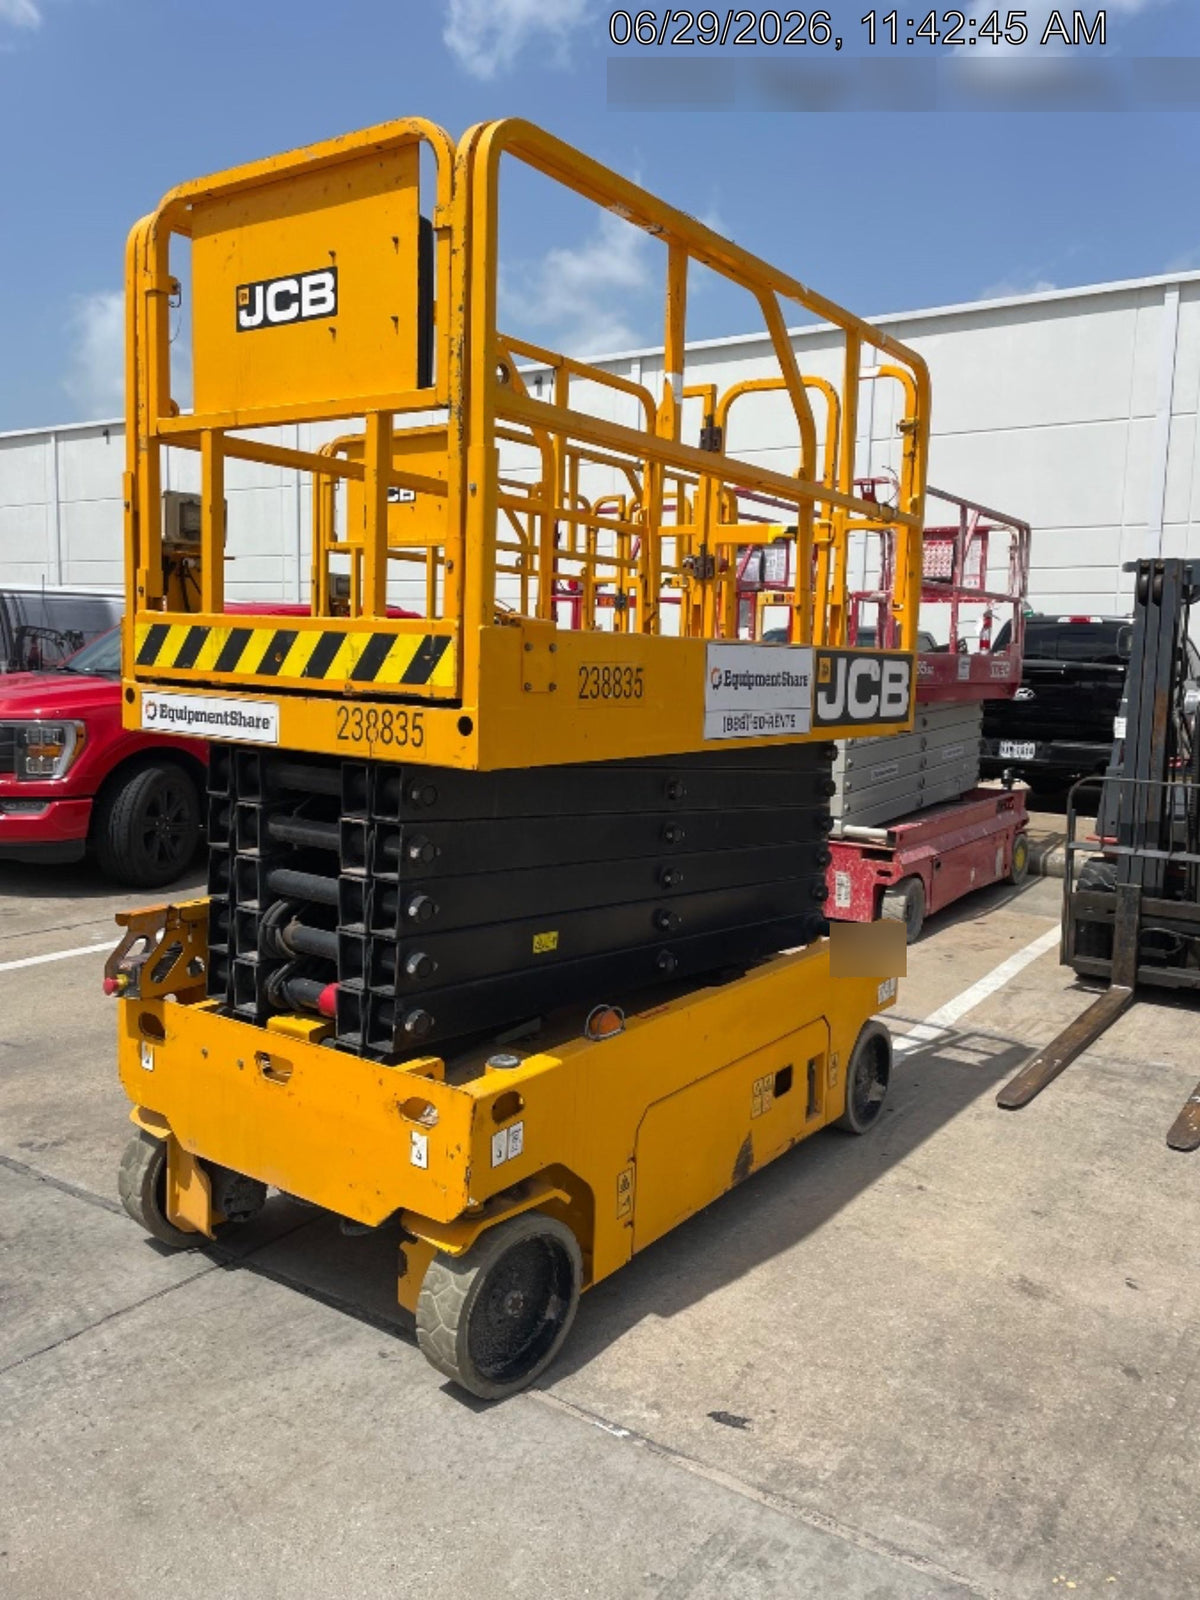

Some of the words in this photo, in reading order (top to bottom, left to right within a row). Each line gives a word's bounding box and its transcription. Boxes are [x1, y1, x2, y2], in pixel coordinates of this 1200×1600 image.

[238, 271, 336, 328] JCB
[578, 666, 644, 700] 238835
[723, 669, 809, 691] EquipmentShare
[816, 657, 910, 720] JCB
[159, 703, 271, 730] EquipmentShare
[336, 705, 425, 748] 238835
